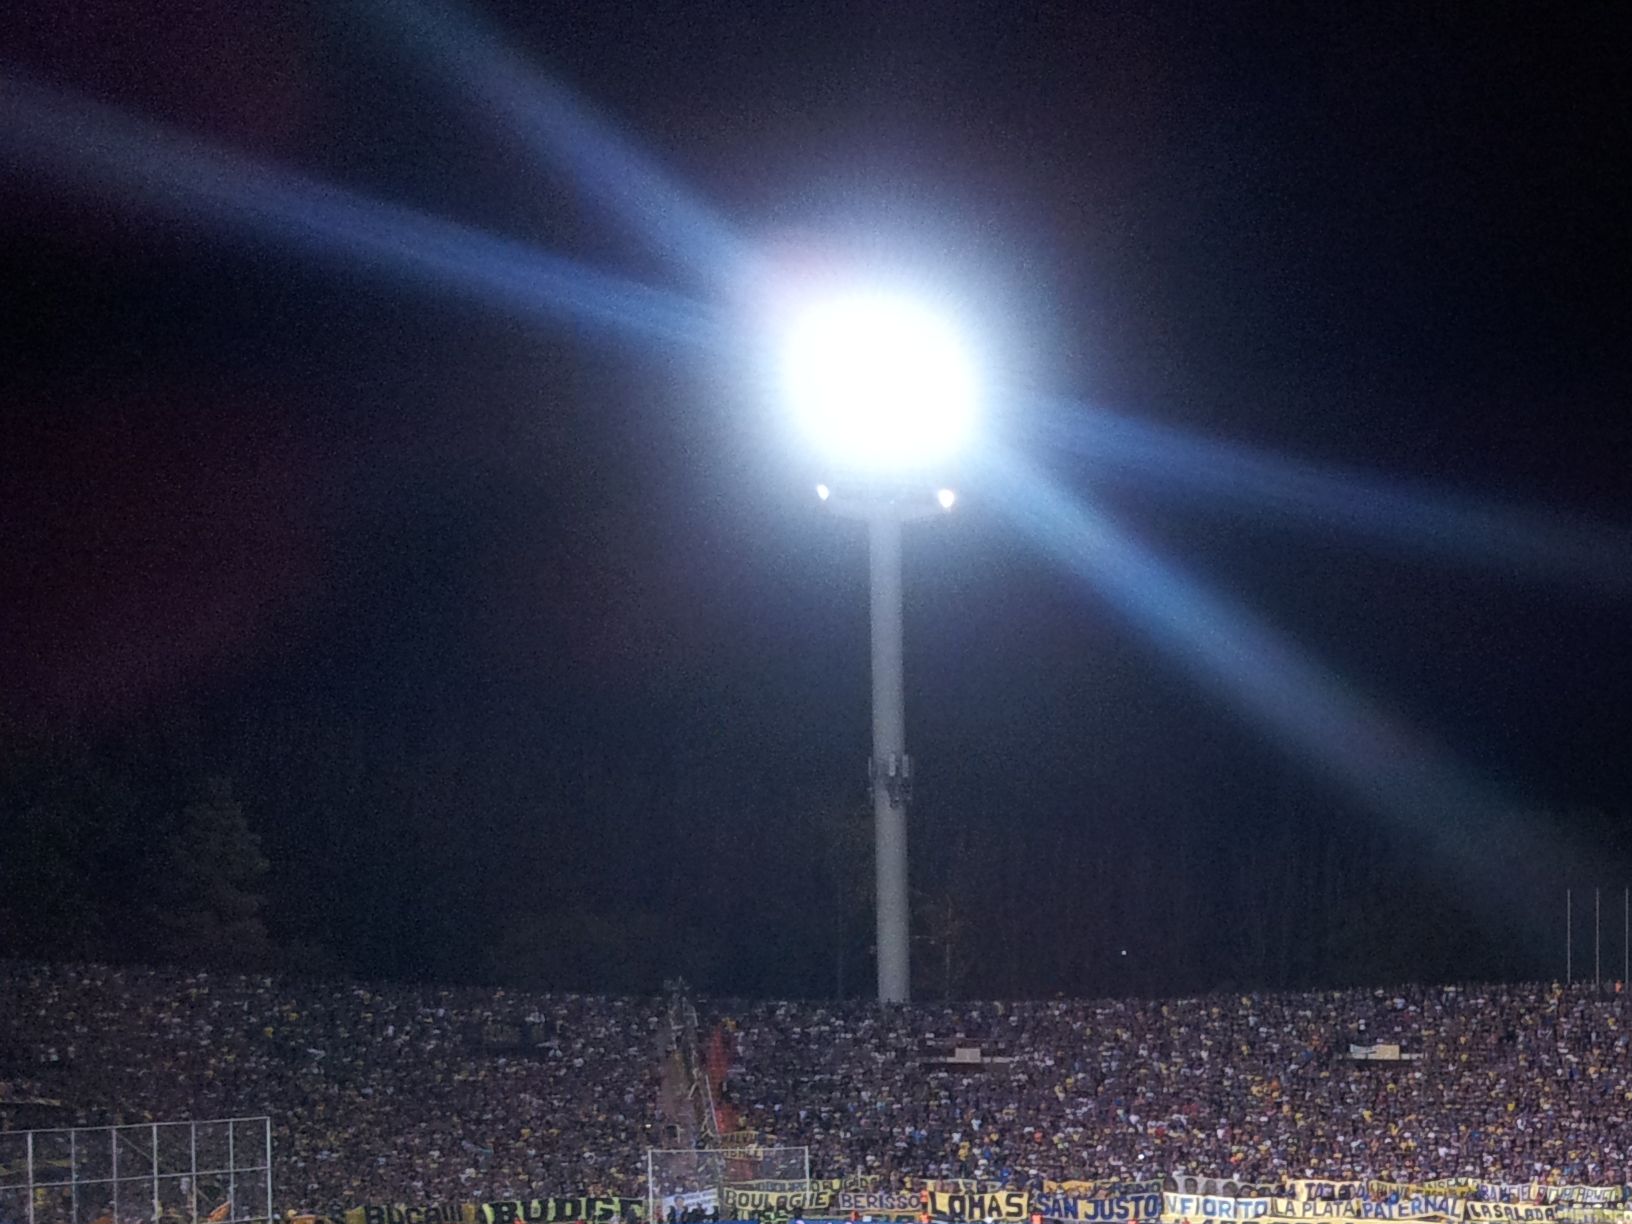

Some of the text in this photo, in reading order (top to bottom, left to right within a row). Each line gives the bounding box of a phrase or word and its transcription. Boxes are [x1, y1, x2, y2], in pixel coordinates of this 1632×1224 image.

[841, 1194, 921, 1210] BERISSO
[929, 1191, 1024, 1219] LOMAS
[1036, 1195, 1158, 1220] SAN JUSTO
[1273, 1200, 1355, 1218] LA PLATA
[1363, 1196, 1462, 1219] PATERNAL
